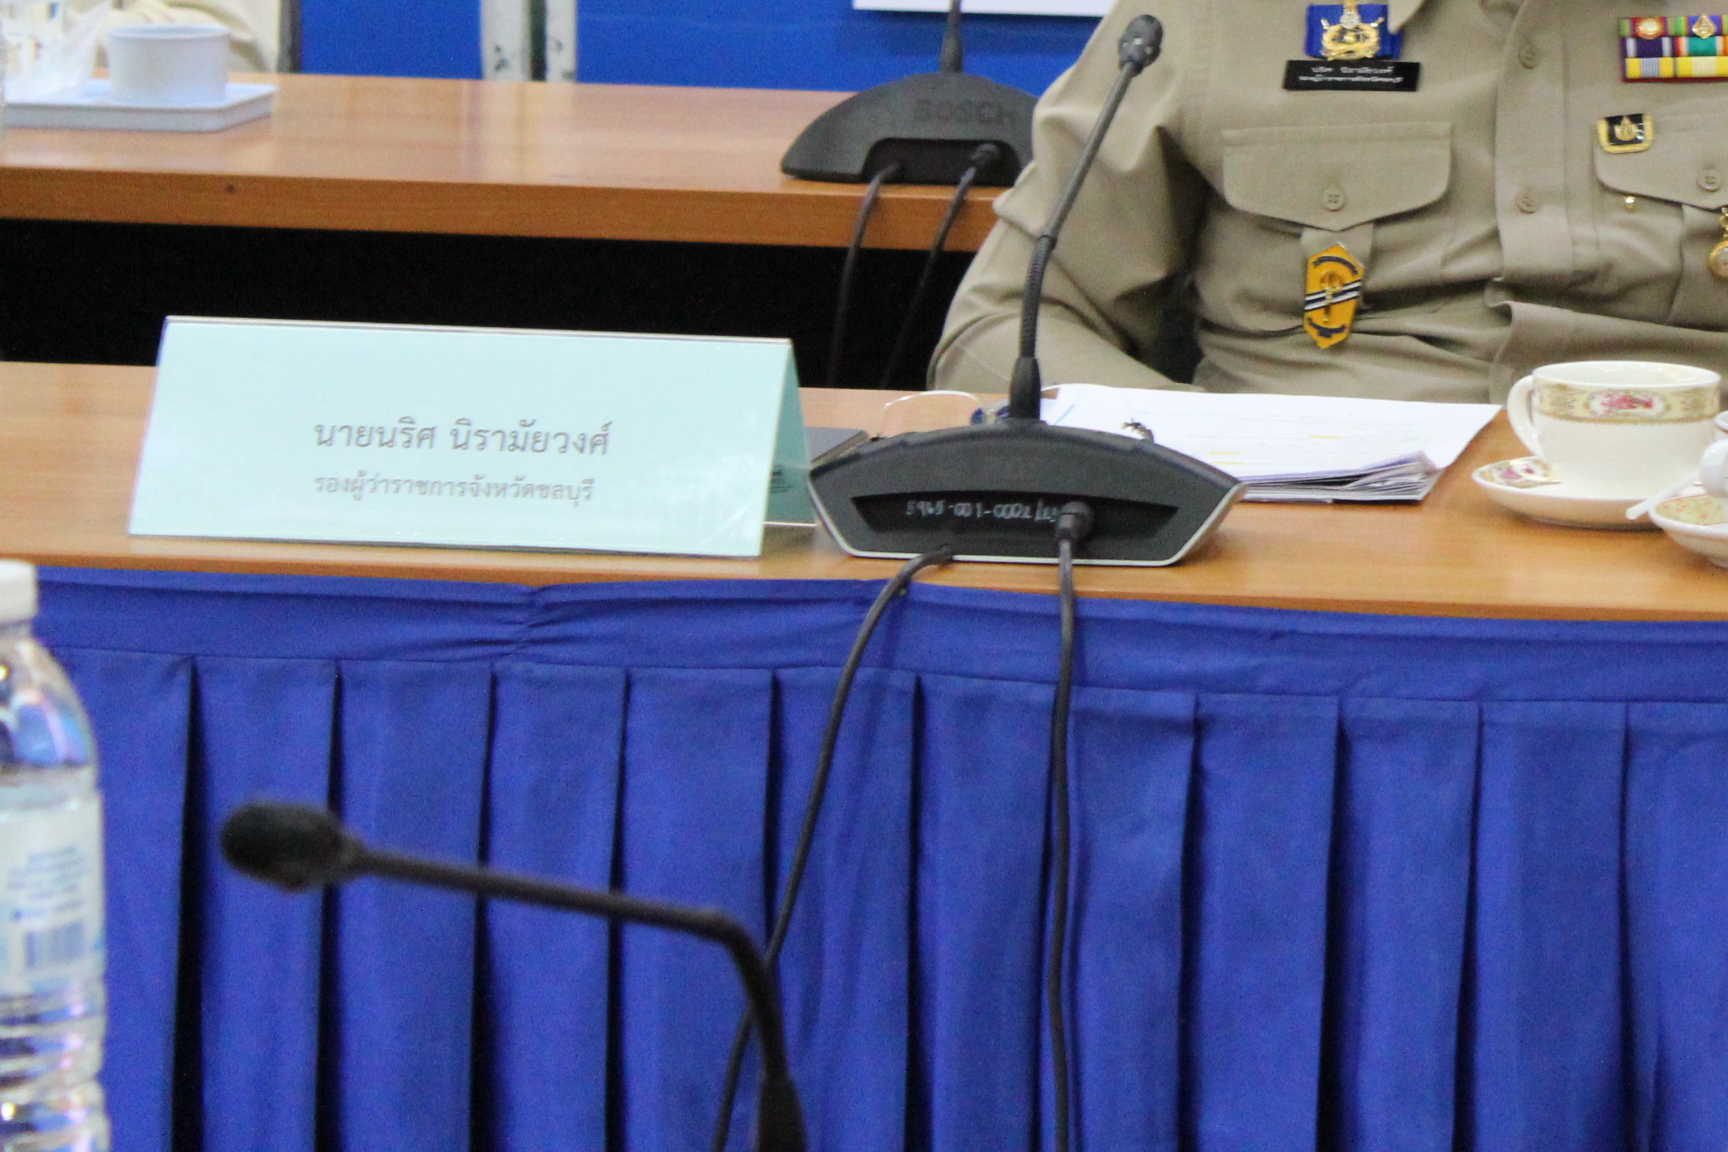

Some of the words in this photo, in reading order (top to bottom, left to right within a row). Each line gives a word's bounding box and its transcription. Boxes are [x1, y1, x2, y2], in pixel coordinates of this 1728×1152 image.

[314, 415, 438, 450] นายนริศ
[449, 417, 613, 457] นิรามัยวงศ์
[314, 469, 595, 508] รองผู้ว่าราชการจังหวัดชลบุรี
